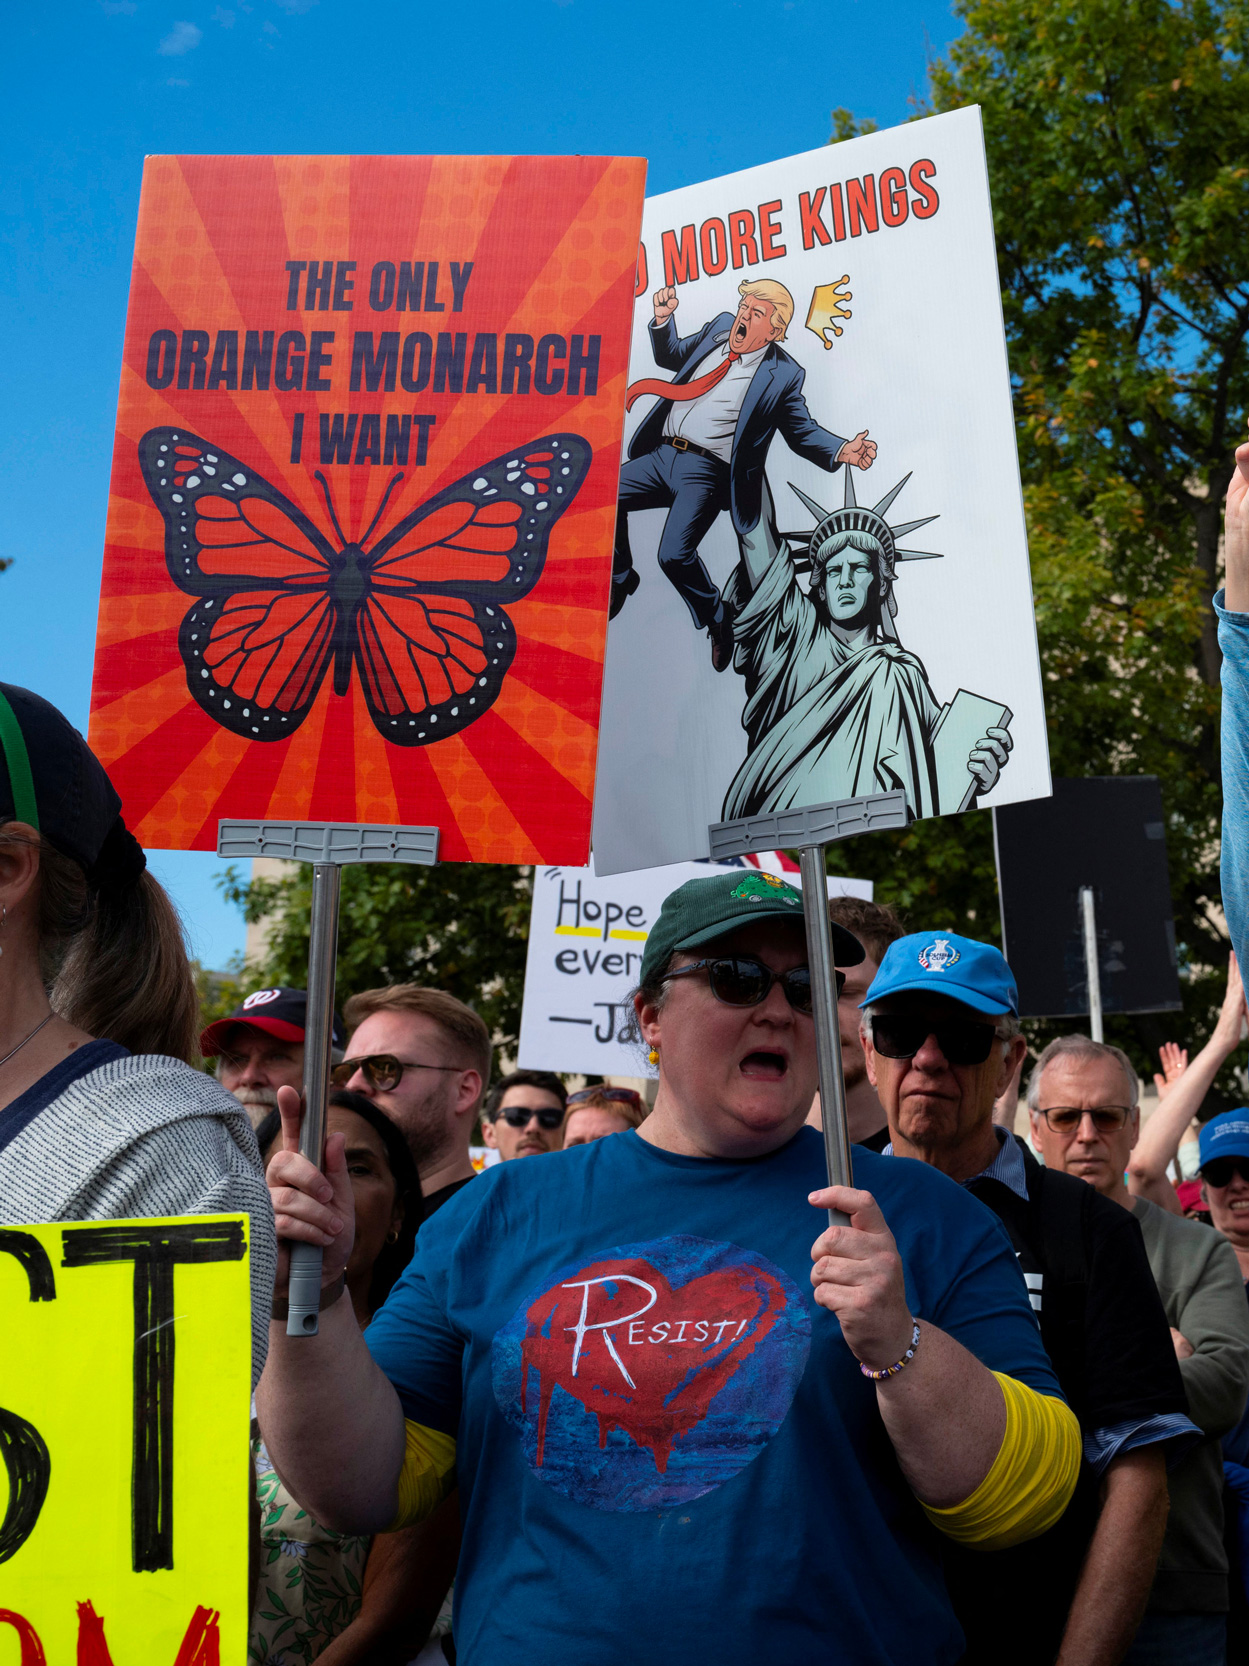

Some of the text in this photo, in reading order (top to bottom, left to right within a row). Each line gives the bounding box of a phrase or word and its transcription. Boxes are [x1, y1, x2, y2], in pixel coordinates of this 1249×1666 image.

[661, 199, 787, 288] MORE
[798, 158, 940, 251] KINGS
[285, 260, 475, 313] THE ONLY
[145, 328, 602, 396] ORANGE MONARCH
[290, 412, 437, 467] I WANT
